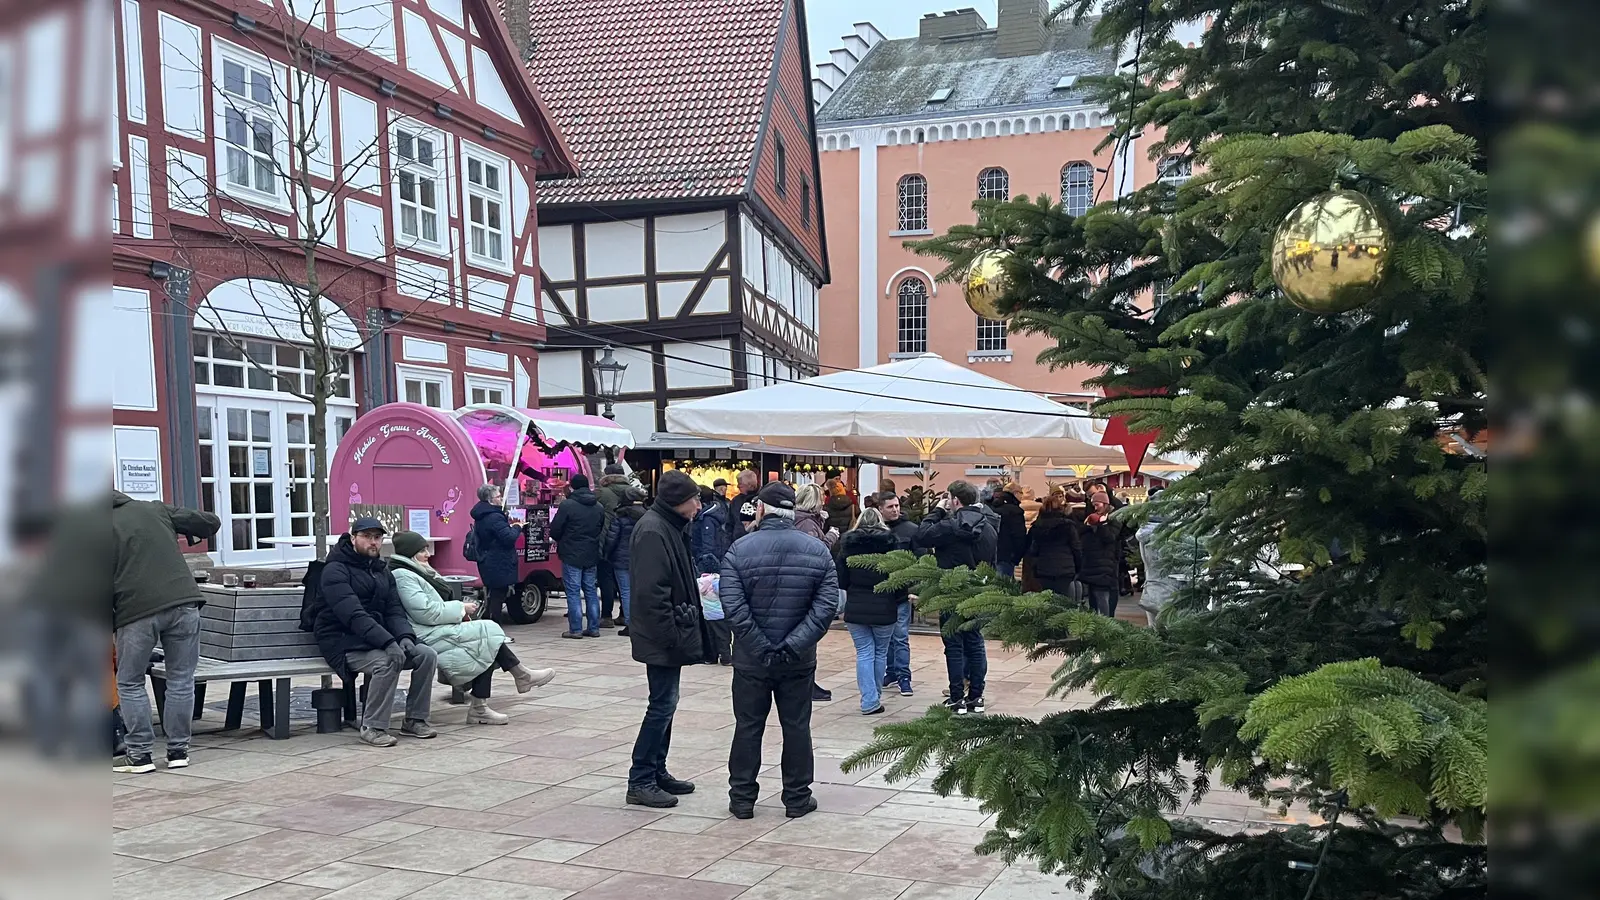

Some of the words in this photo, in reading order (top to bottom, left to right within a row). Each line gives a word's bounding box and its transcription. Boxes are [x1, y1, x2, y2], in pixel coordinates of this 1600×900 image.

[353, 436, 377, 465] Mobile
[379, 423, 410, 438] Genuss
[415, 426, 450, 465] Ambulanz
